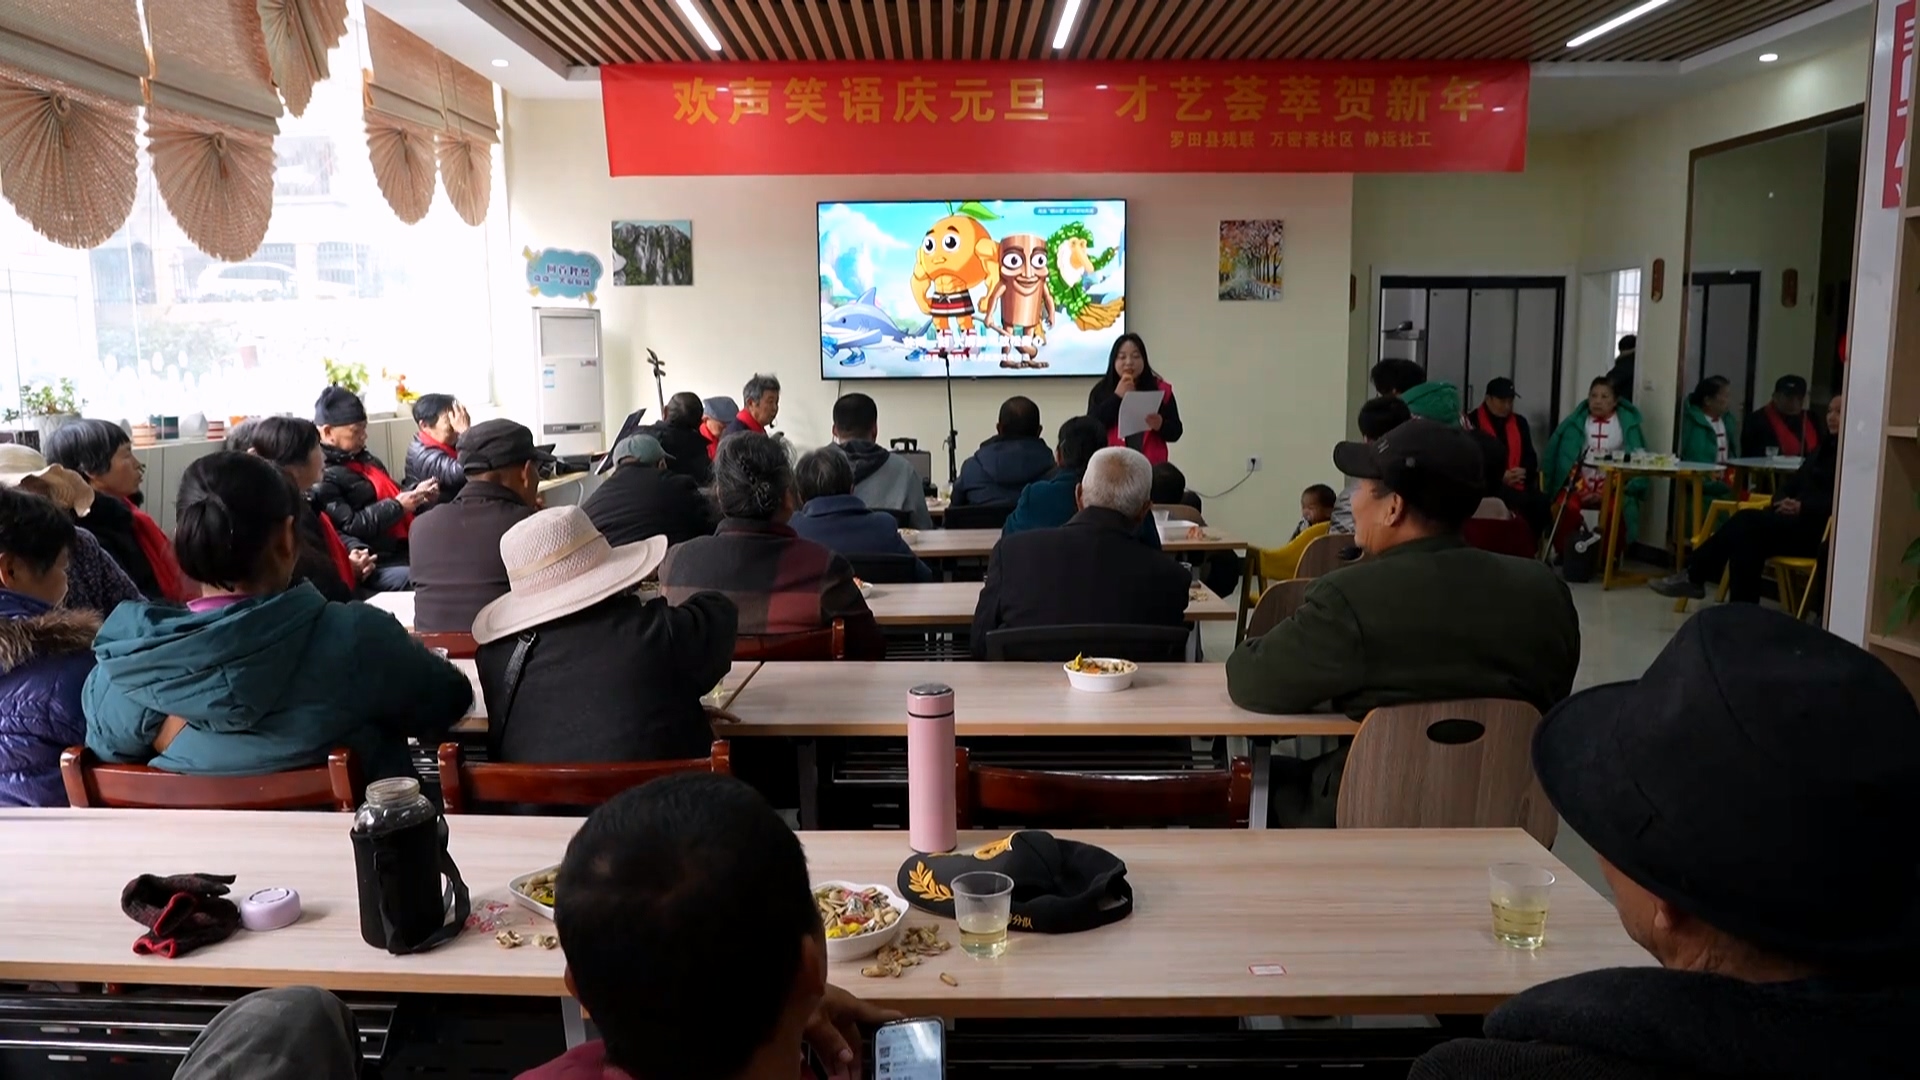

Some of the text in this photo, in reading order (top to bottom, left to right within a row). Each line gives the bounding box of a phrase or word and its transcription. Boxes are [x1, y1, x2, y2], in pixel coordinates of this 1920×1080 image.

[672, 75, 1485, 125] 欢声笑语庆元旦 才艺荟萃贺新年
[1169, 130, 1255, 149] 罗田县残联
[1364, 131, 1432, 148] 静远社工
